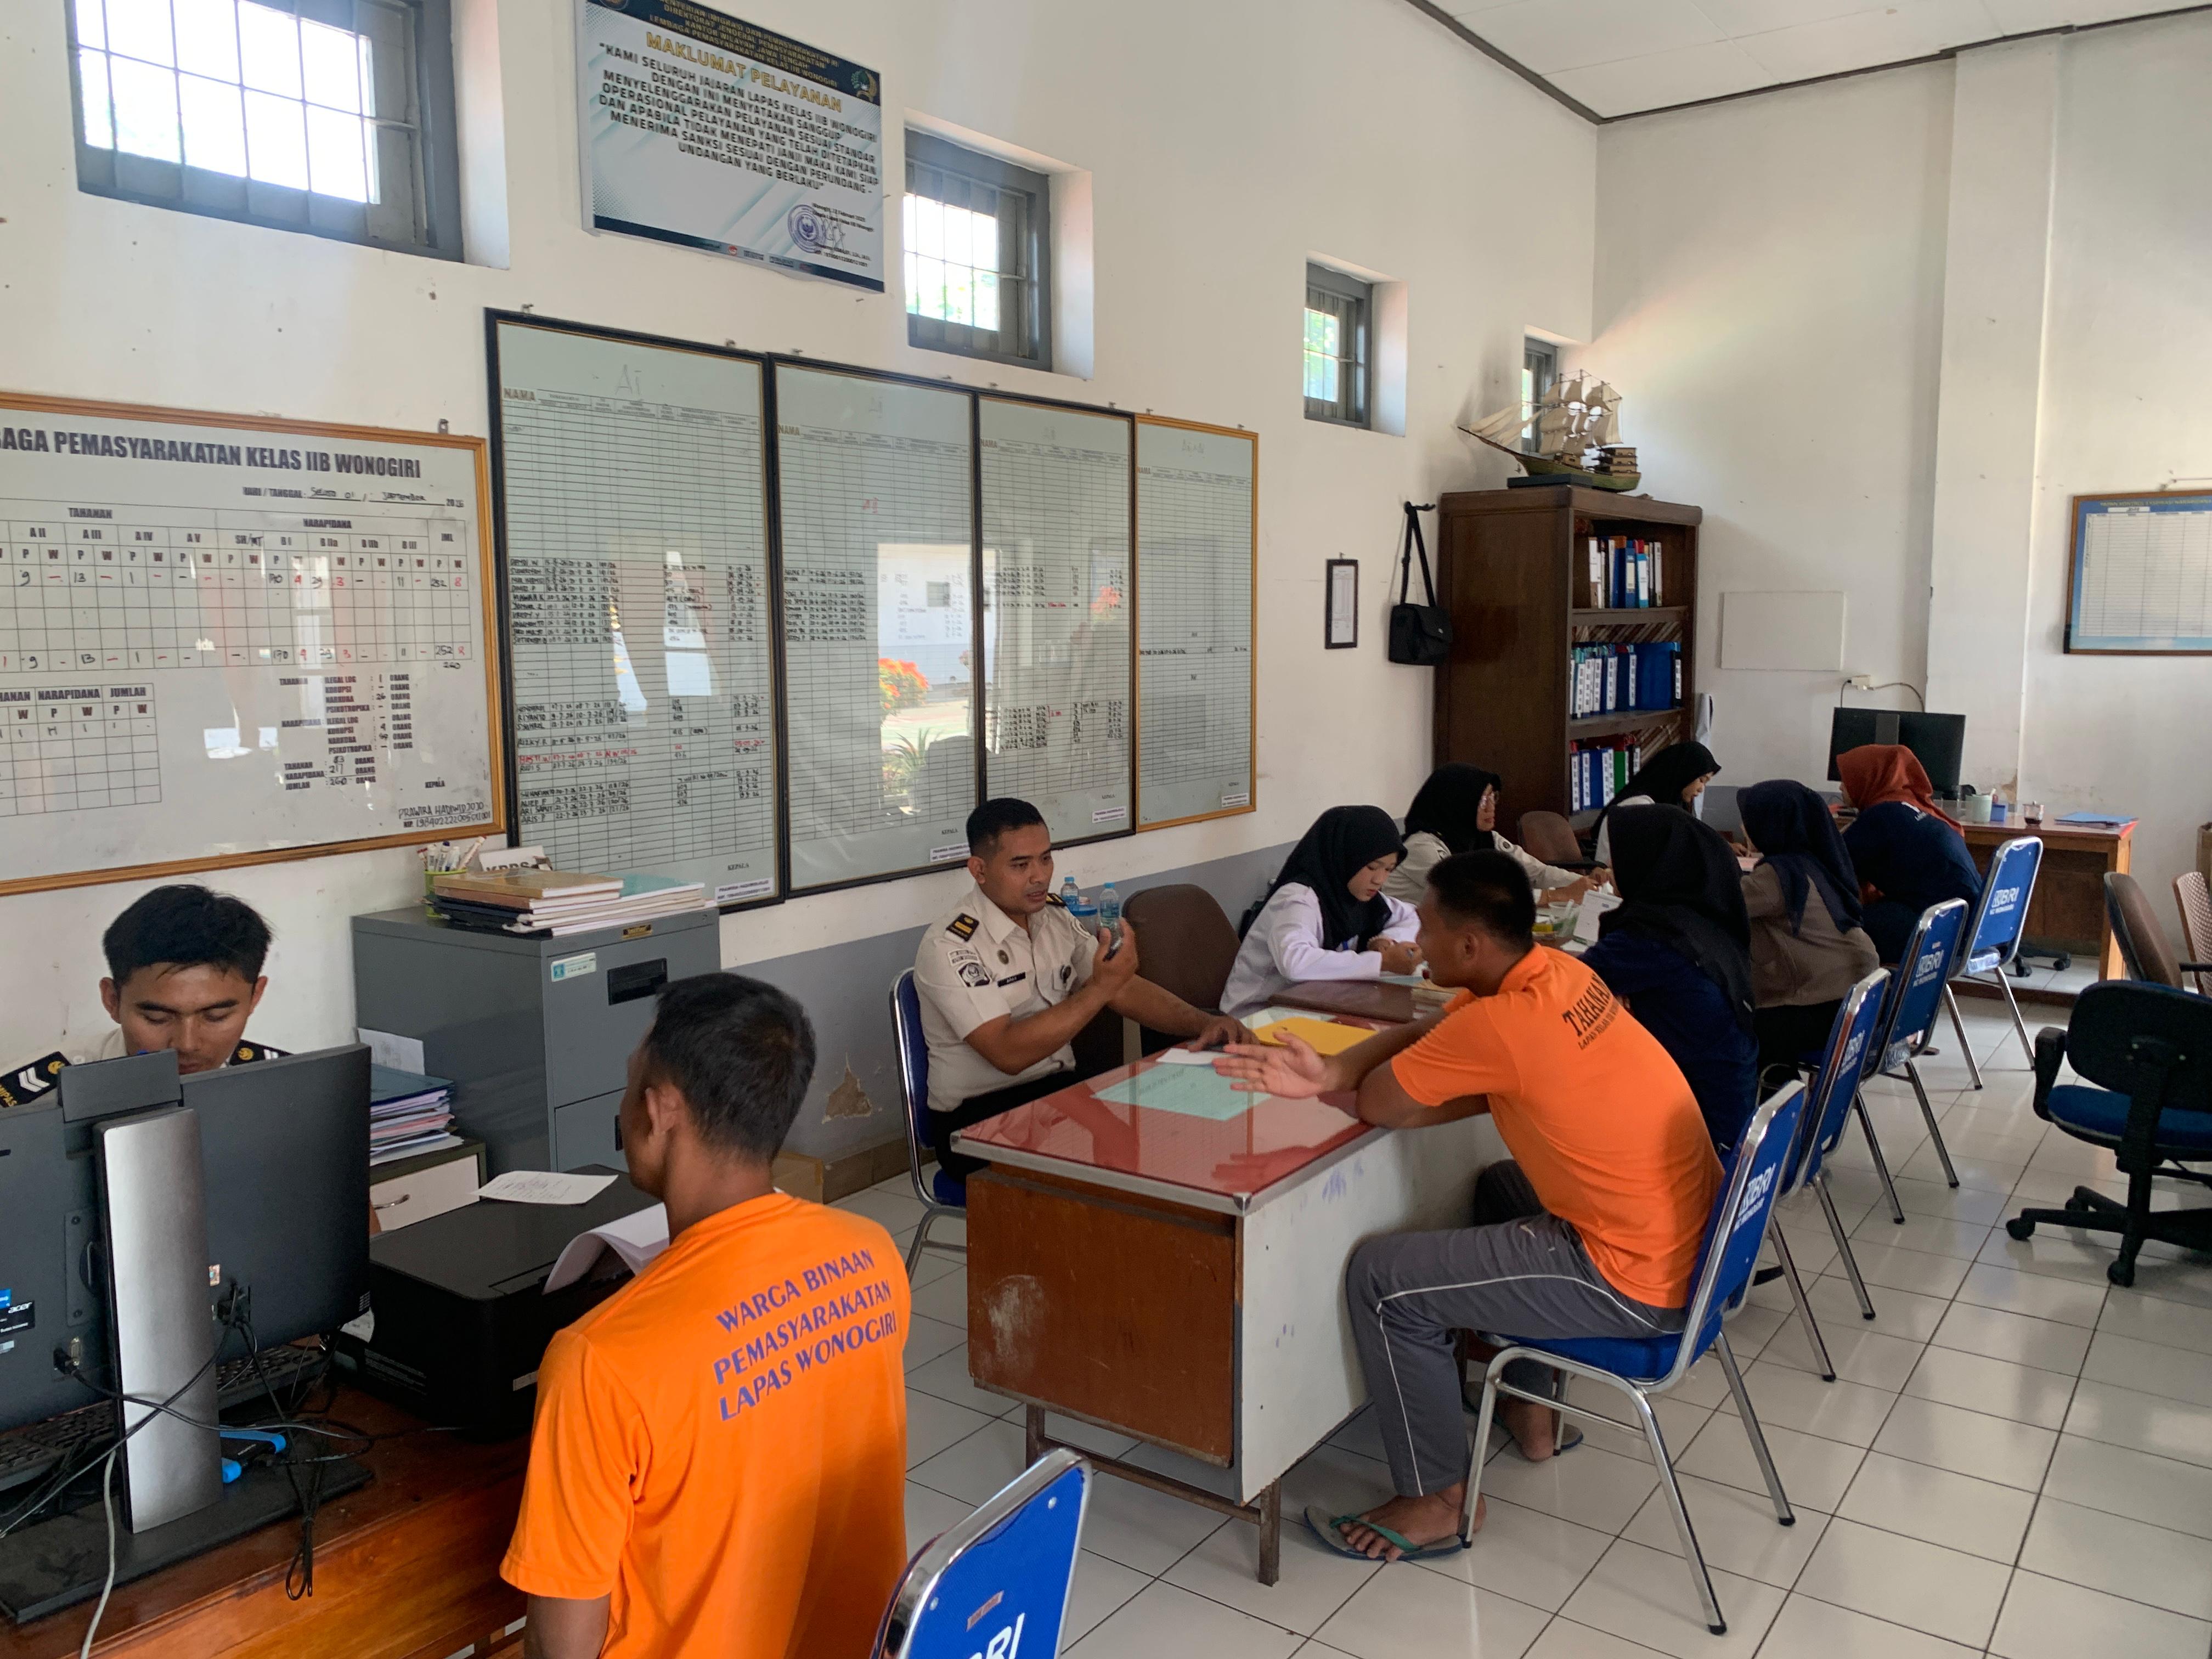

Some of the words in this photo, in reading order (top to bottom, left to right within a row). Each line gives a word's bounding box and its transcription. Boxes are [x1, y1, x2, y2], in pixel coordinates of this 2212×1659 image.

[664, 4, 715, 27] DIREKTORAT
[685, 20, 718, 36] KANTOR
[720, 31, 755, 49] WILAYAH
[650, 14, 691, 35] LEMBAGA
[693, 29, 765, 61] PEMASYARAKATAN
[766, 55, 789, 68] KELAS
[802, 69, 838, 88] WONOGIRI
[646, 31, 747, 79] MAKLUMAT
[750, 67, 842, 113] PELAYANAN
[642, 56, 697, 83] SELURUH
[748, 88, 781, 110] LAPAS
[783, 99, 813, 121] KELAS
[815, 113, 828, 126] IIB
[831, 119, 878, 143] WONOGIRI
[651, 71, 699, 96] DENGAN
[703, 88, 720, 102] INI
[722, 95, 794, 126] MENYATAKAN
[796, 119, 841, 141] SANGGUP
[603, 69, 732, 119] MENYELENGGARAKAN
[735, 110, 795, 138] PELAYANAN
[798, 131, 833, 150] SESUAI
[834, 142, 876, 164] STANDAR
[602, 82, 688, 117] OPERASIONAL
[690, 109, 755, 137] PELAYANAN
[758, 129, 786, 146] YANG
[788, 139, 819, 157] TELAH
[821, 149, 878, 175] DITETAPKAN
[599, 93, 626, 111] DAN
[629, 103, 680, 127] APABILA
[684, 118, 718, 137] TIDAK
[720, 129, 775, 154] MENEPATI
[804, 155, 832, 172] MAKA
[833, 163, 857, 179] KAMI
[859, 172, 879, 185] SIAP
[610, 109, 679, 139] MENERIMA
[681, 129, 724, 151] SANKSI
[725, 143, 764, 162] SESUAI
[766, 155, 808, 176] DENGAN
[809, 168, 866, 194] PERUNDANG
[678, 141, 742, 168] UNDANGAN
[744, 160, 773, 177] YANG
[777, 424, 800, 437] NAMA
[0, 427, 49, 452] AGA
[53, 430, 242, 466] PEMASYARAKATAN
[245, 445, 302, 471] KELAS
[306, 450, 331, 473] IIB
[334, 453, 421, 479] WONOGIRI
[67, 507, 113, 520] TAHANAN
[303, 518, 352, 529] NARAPIDANA
[29, 528, 37, 537] A
[82, 529, 90, 539] A
[135, 531, 142, 540] A
[187, 533, 193, 542] A
[22, 550, 30, 558] P
[48, 550, 58, 559] W
[78, 550, 84, 560] P
[102, 551, 112, 560] W
[130, 551, 136, 561] P
[154, 552, 163, 562] W
[180, 552, 185, 562] P
[228, 555, 234, 563] P
[249, 555, 258, 564] W
[274, 555, 279, 564] P
[337, 557, 345, 566] W
[377, 557, 385, 567] W
[416, 559, 424, 568] W
[336, 577, 344, 586] 3
[38, 689, 100, 701] NARAPIDANA
[110, 687, 146, 697] JUMLAH
[325, 696, 354, 704] NARKOBA
[18, 709, 29, 719] W
[50, 708, 58, 718] P
[82, 707, 93, 716] W
[114, 706, 120, 715] P
[326, 704, 370, 713] PSIKOTROPIKA
[281, 719, 321, 727] NARAPIDANA
[328, 736, 357, 744] NARKOBA
[328, 744, 373, 755] PSIKOTROPIKA
[284, 761, 313, 771] TAHANAN
[355, 757, 375, 765] ORANG
[285, 770, 324, 780] NARAPIDANA
[285, 781, 311, 791] JUMLAH
[356, 776, 376, 785] ORANG
[425, 780, 445, 788] KEPALA
[398, 804, 433, 820] PRAWIRA
[1562, 973, 1613, 1037] TAHANAN
[715, 1278, 802, 1334] WARGA
[802, 1248, 875, 1293] BINAAN
[8, 1301, 32, 1314] acer
[713, 1278, 893, 1386] PEMASYARAKATAN
[719, 1359, 793, 1422] LAPAS
[795, 1310, 898, 1374] WONOGIRI
